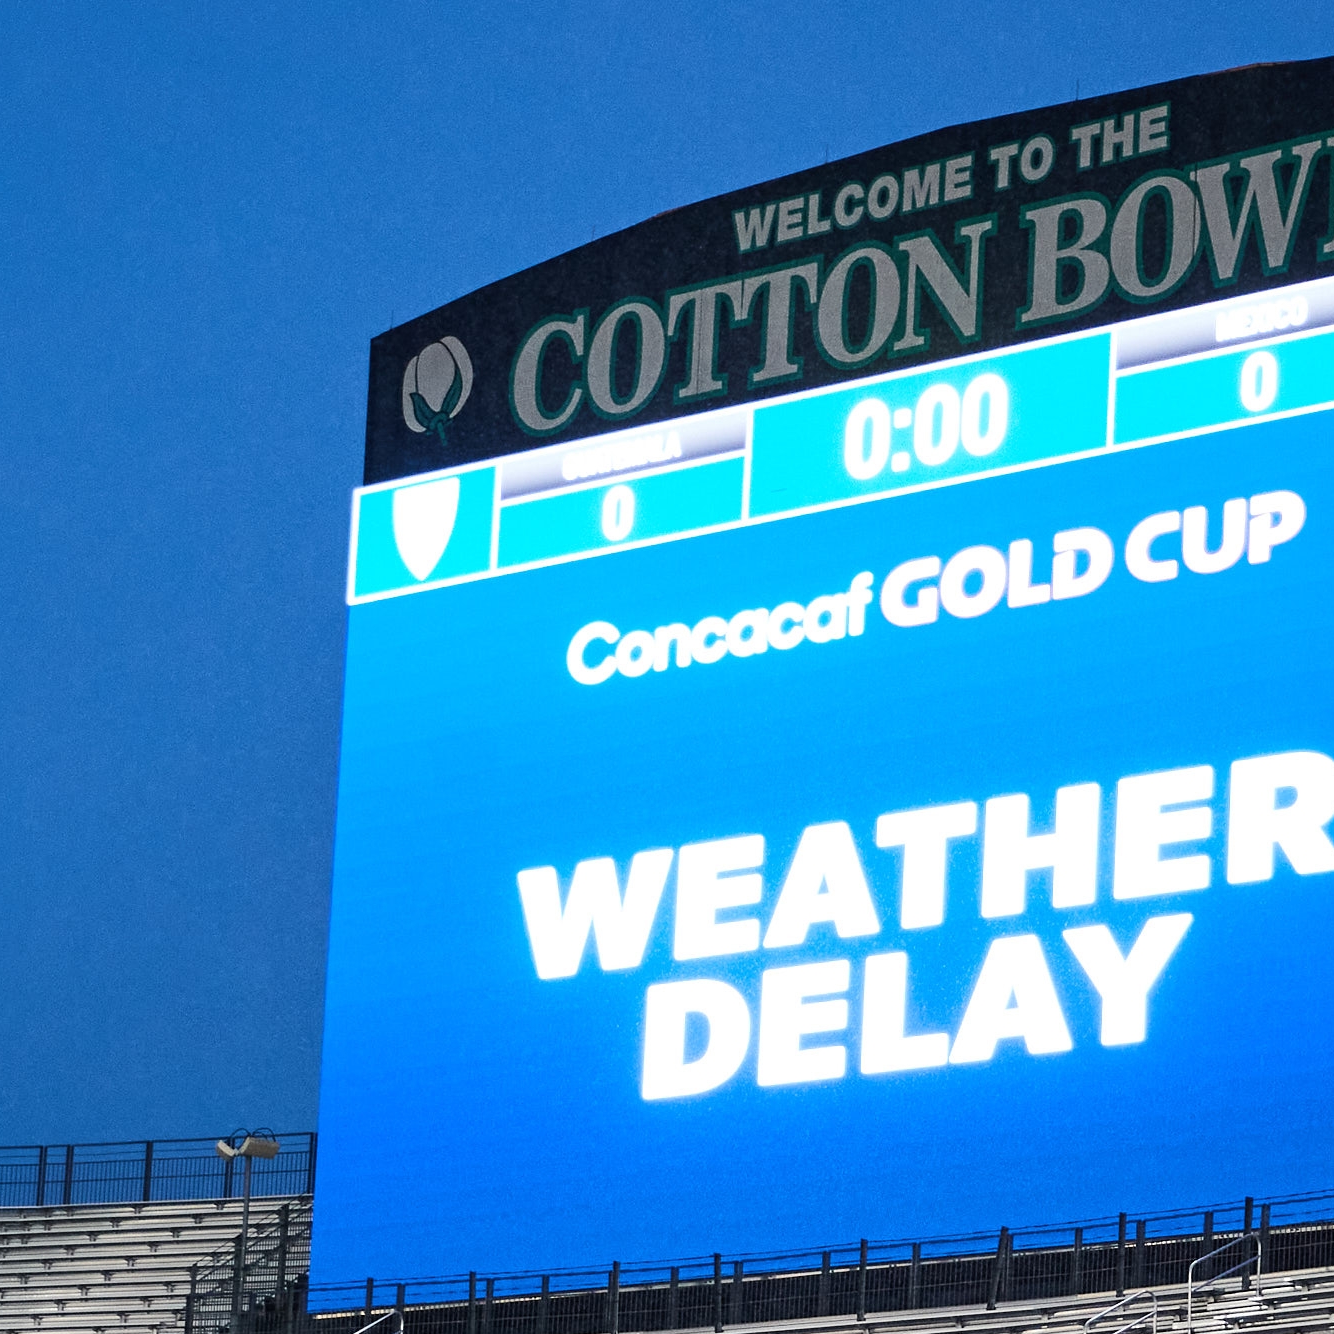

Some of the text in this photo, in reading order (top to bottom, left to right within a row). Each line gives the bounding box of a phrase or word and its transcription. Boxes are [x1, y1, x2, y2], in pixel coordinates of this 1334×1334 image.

[732, 103, 1170, 256] WELCOME TO THE
[512, 215, 989, 432] COTTON
[1240, 350, 1278, 412] 0
[842, 373, 1009, 479] 0:00
[567, 491, 1307, 686] Concacaf GOLD CUP
[602, 484, 635, 541] 0
[640, 913, 1194, 1101] DELAY
